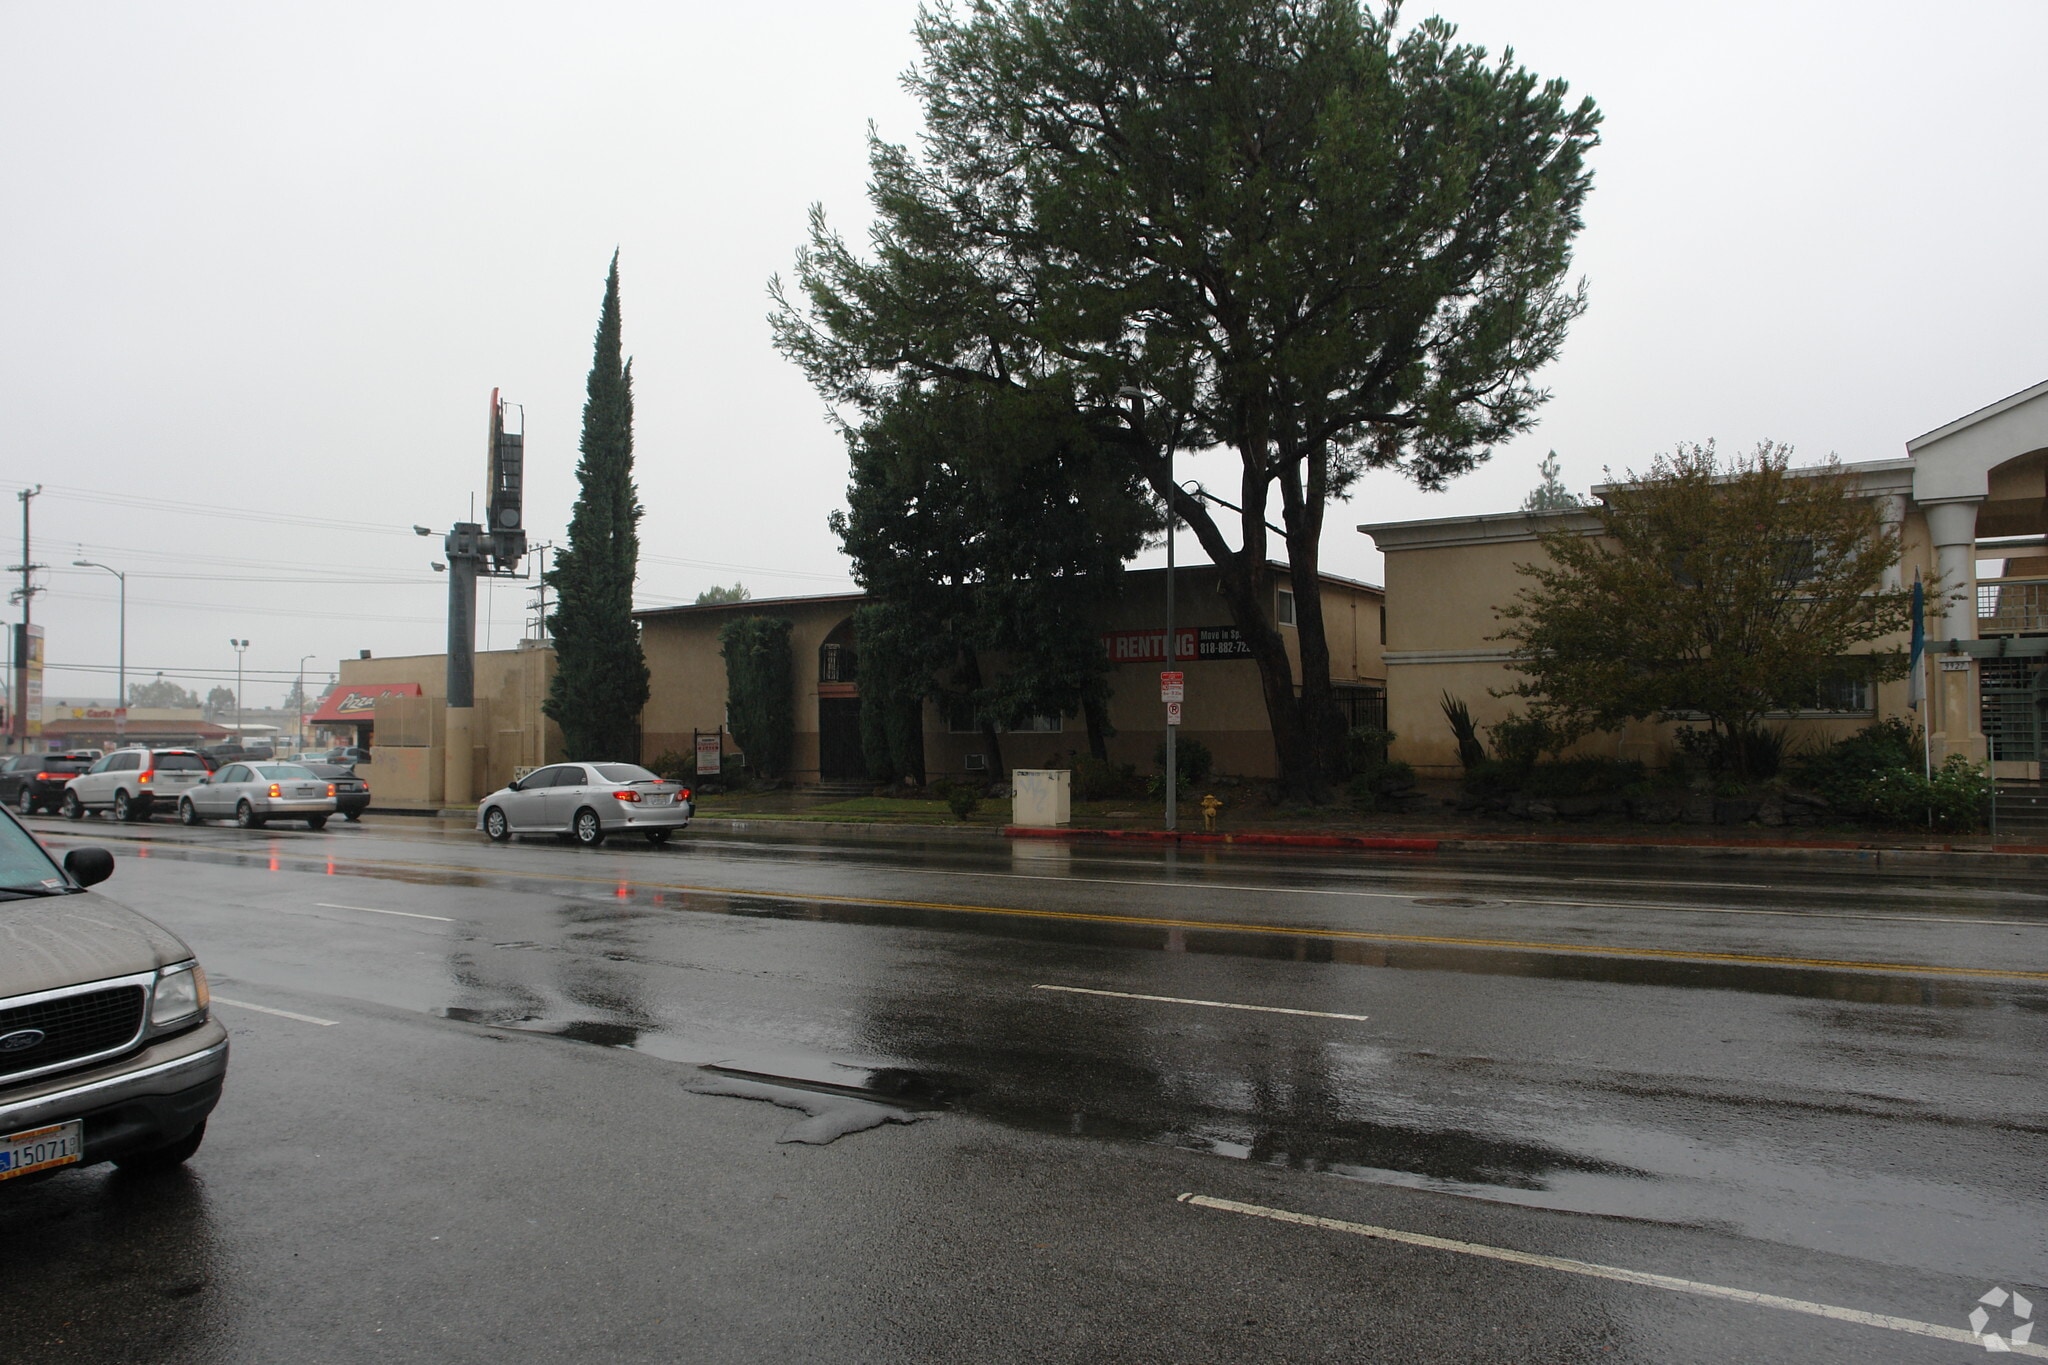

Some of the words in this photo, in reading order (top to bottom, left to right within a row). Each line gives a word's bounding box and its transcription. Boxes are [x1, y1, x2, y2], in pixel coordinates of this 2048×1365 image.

[1200, 630, 1220, 640] Move
[1221, 630, 1229, 640] in
[1230, 629, 1242, 641] Sp
[336, 692, 375, 711] Pizza
[5, 1034, 34, 1048] Ford
[12, 1138, 69, 1170] 15071
